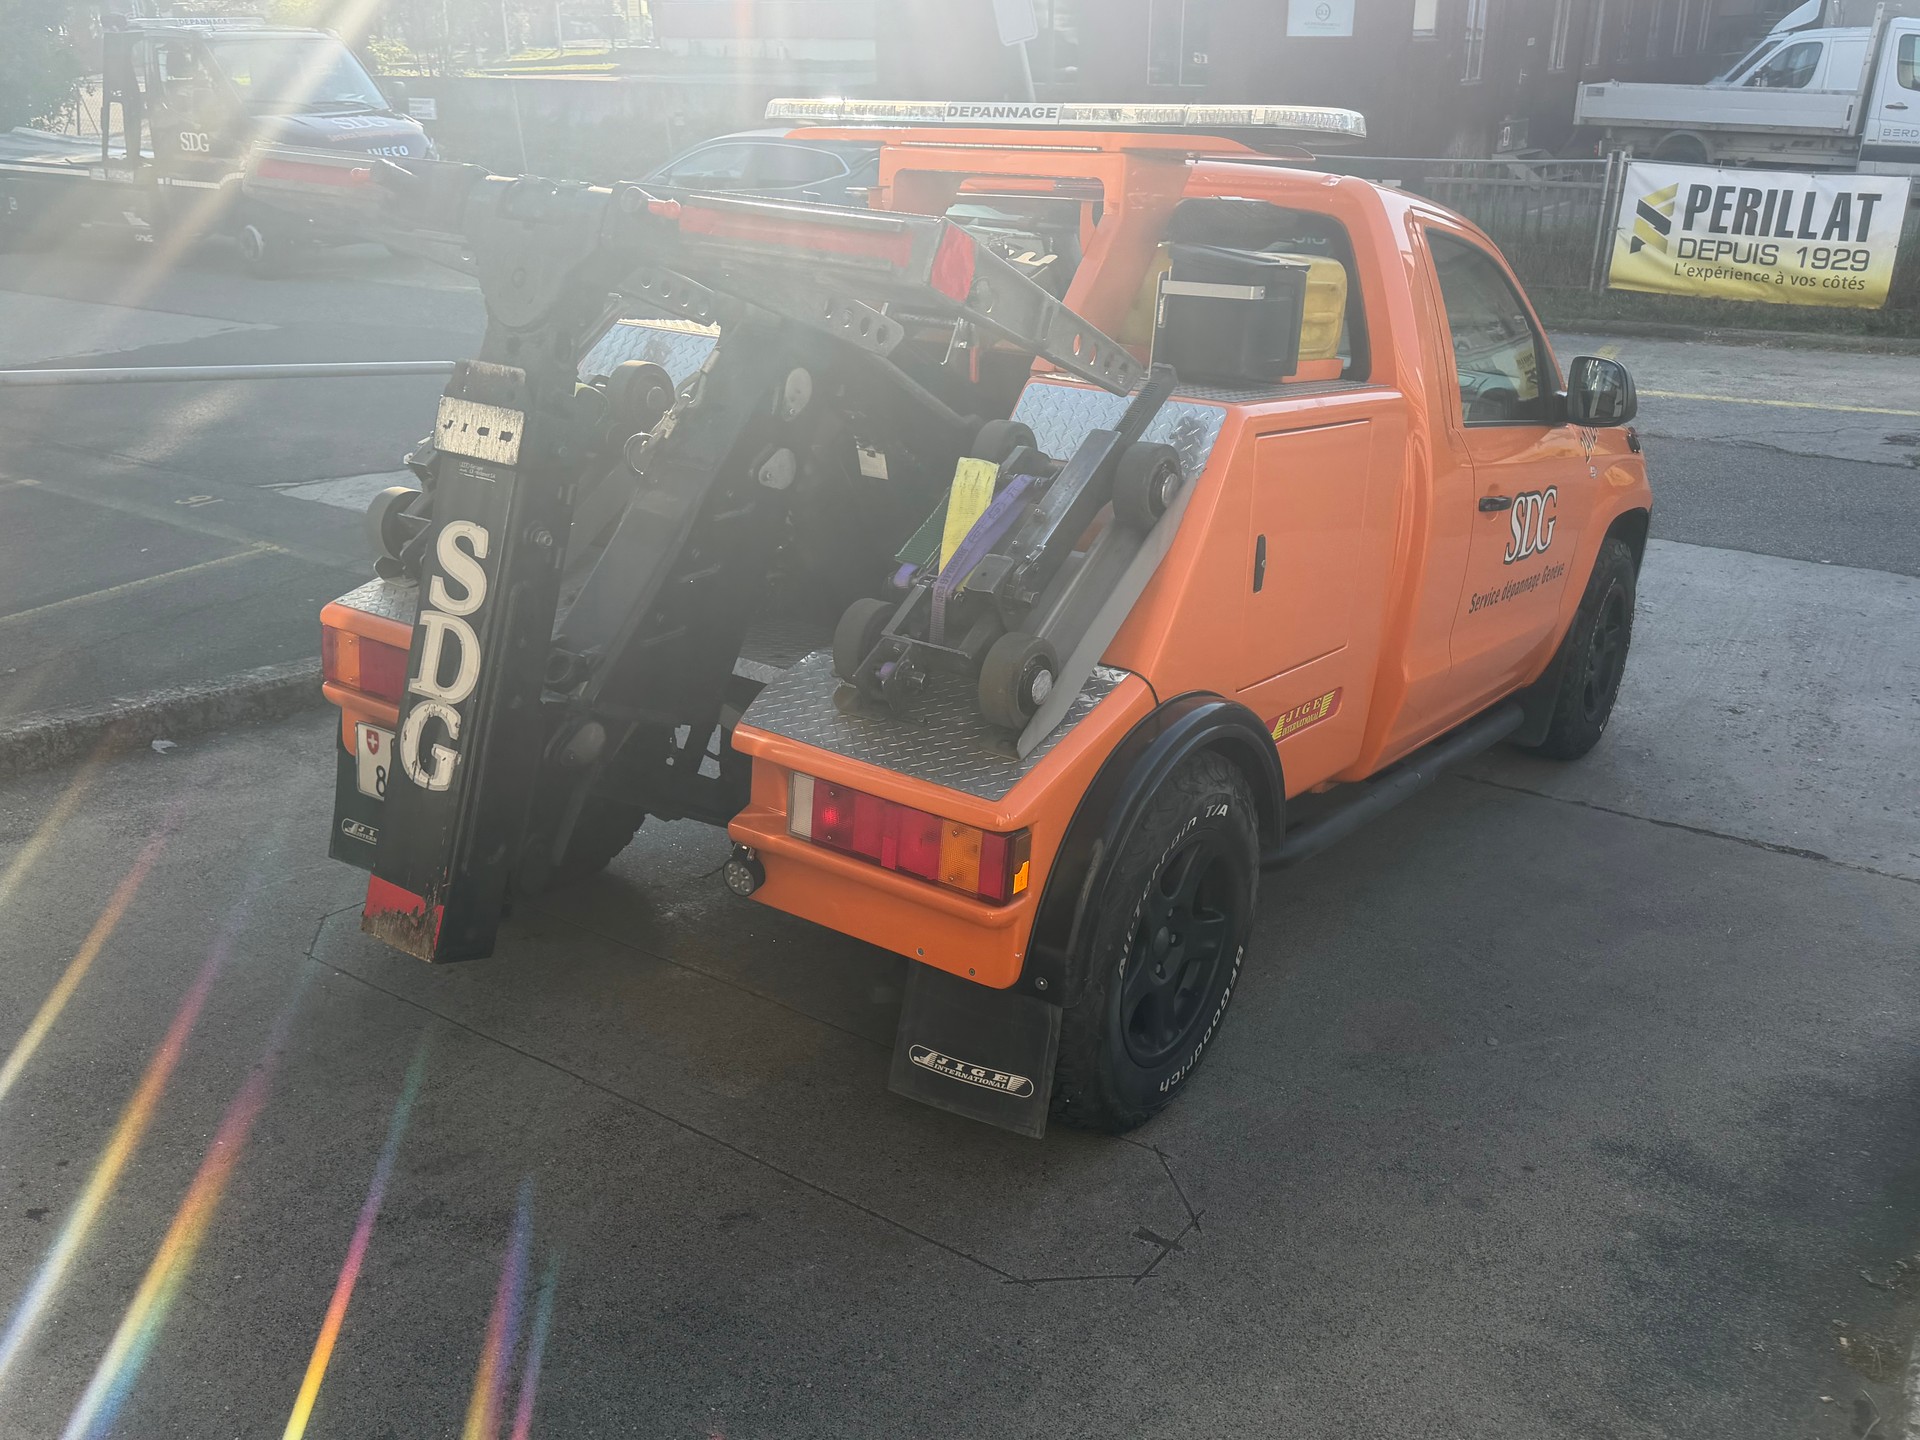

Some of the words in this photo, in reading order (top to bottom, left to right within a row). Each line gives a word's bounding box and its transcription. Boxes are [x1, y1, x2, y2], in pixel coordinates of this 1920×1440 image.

[946, 105, 1058, 119] DEPANNAGE
[180, 132, 210, 152] SDG
[1682, 184, 1882, 242] PERILLAT
[1677, 237, 1779, 266] DEPUIS
[1796, 246, 1870, 272] 1929
[1674, 262, 1770, 283] L'expérience
[1775, 270, 1784, 284] à
[1790, 275, 1816, 287] vos
[1822, 275, 1866, 291] côtés
[1503, 485, 1558, 565] SDG
[1469, 587, 1500, 614] Service
[1501, 572, 1541, 601] dépannage
[1541, 561, 1565, 585] Genève
[400, 520, 489, 791] SDG
[1285, 698, 1322, 723] JIGE
[1206, 803, 1229, 818] T/A
[1159, 945, 1244, 1093] BFGoodrich
[933, 1063, 1008, 1090] INTERNATIONAL
[937, 1056, 1009, 1083] JIGE
